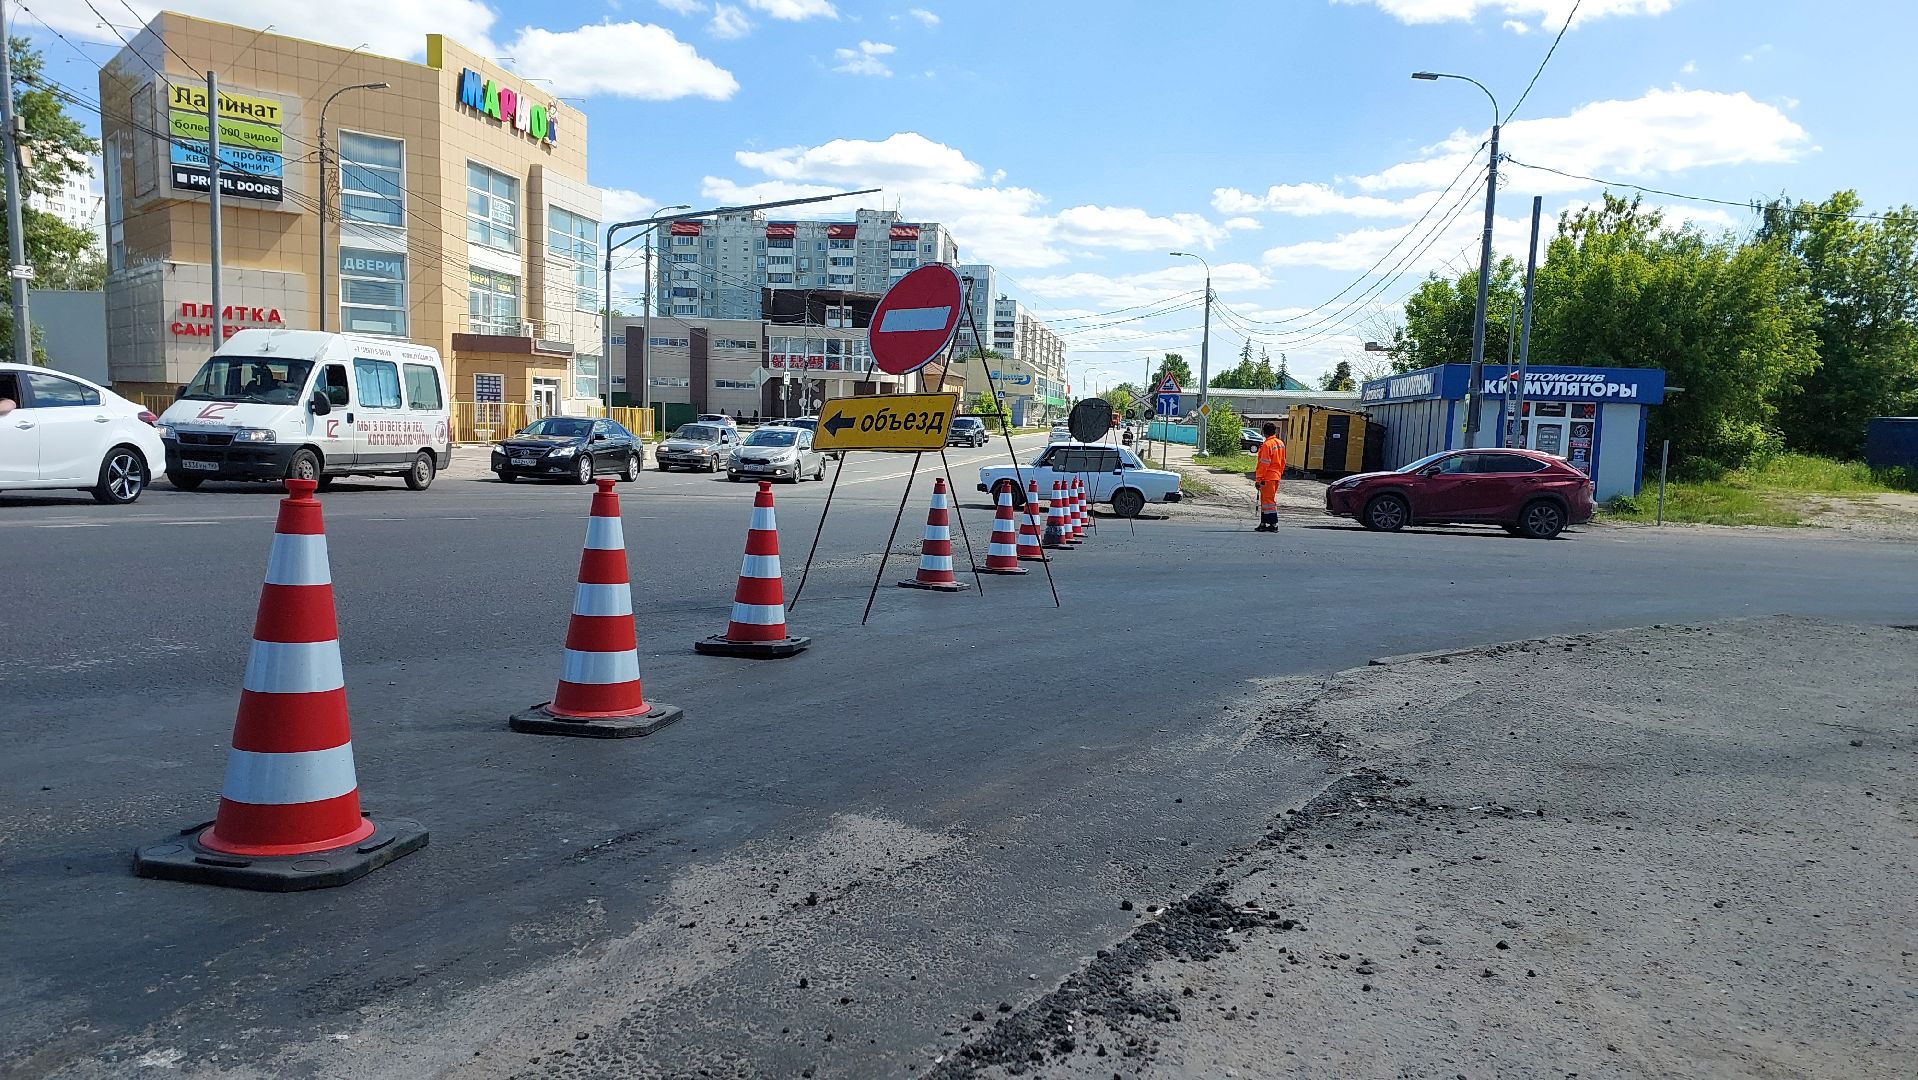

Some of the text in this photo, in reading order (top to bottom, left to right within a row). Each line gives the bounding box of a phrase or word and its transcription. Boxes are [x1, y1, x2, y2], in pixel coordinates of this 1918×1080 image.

[461, 67, 547, 139] МАРИО
[218, 126, 240, 137] 000
[243, 132, 279, 144] видов
[232, 150, 275, 164] пробка
[233, 161, 271, 173] винил
[237, 181, 280, 196] DOORS
[344, 257, 396, 273] ДВЕРИ
[356, 420, 371, 432] МЫ
[379, 420, 402, 432] ОТВЕТЕ
[403, 421, 411, 433] ЗА
[860, 407, 945, 435] объезд
[367, 433, 385, 446] КОГО
